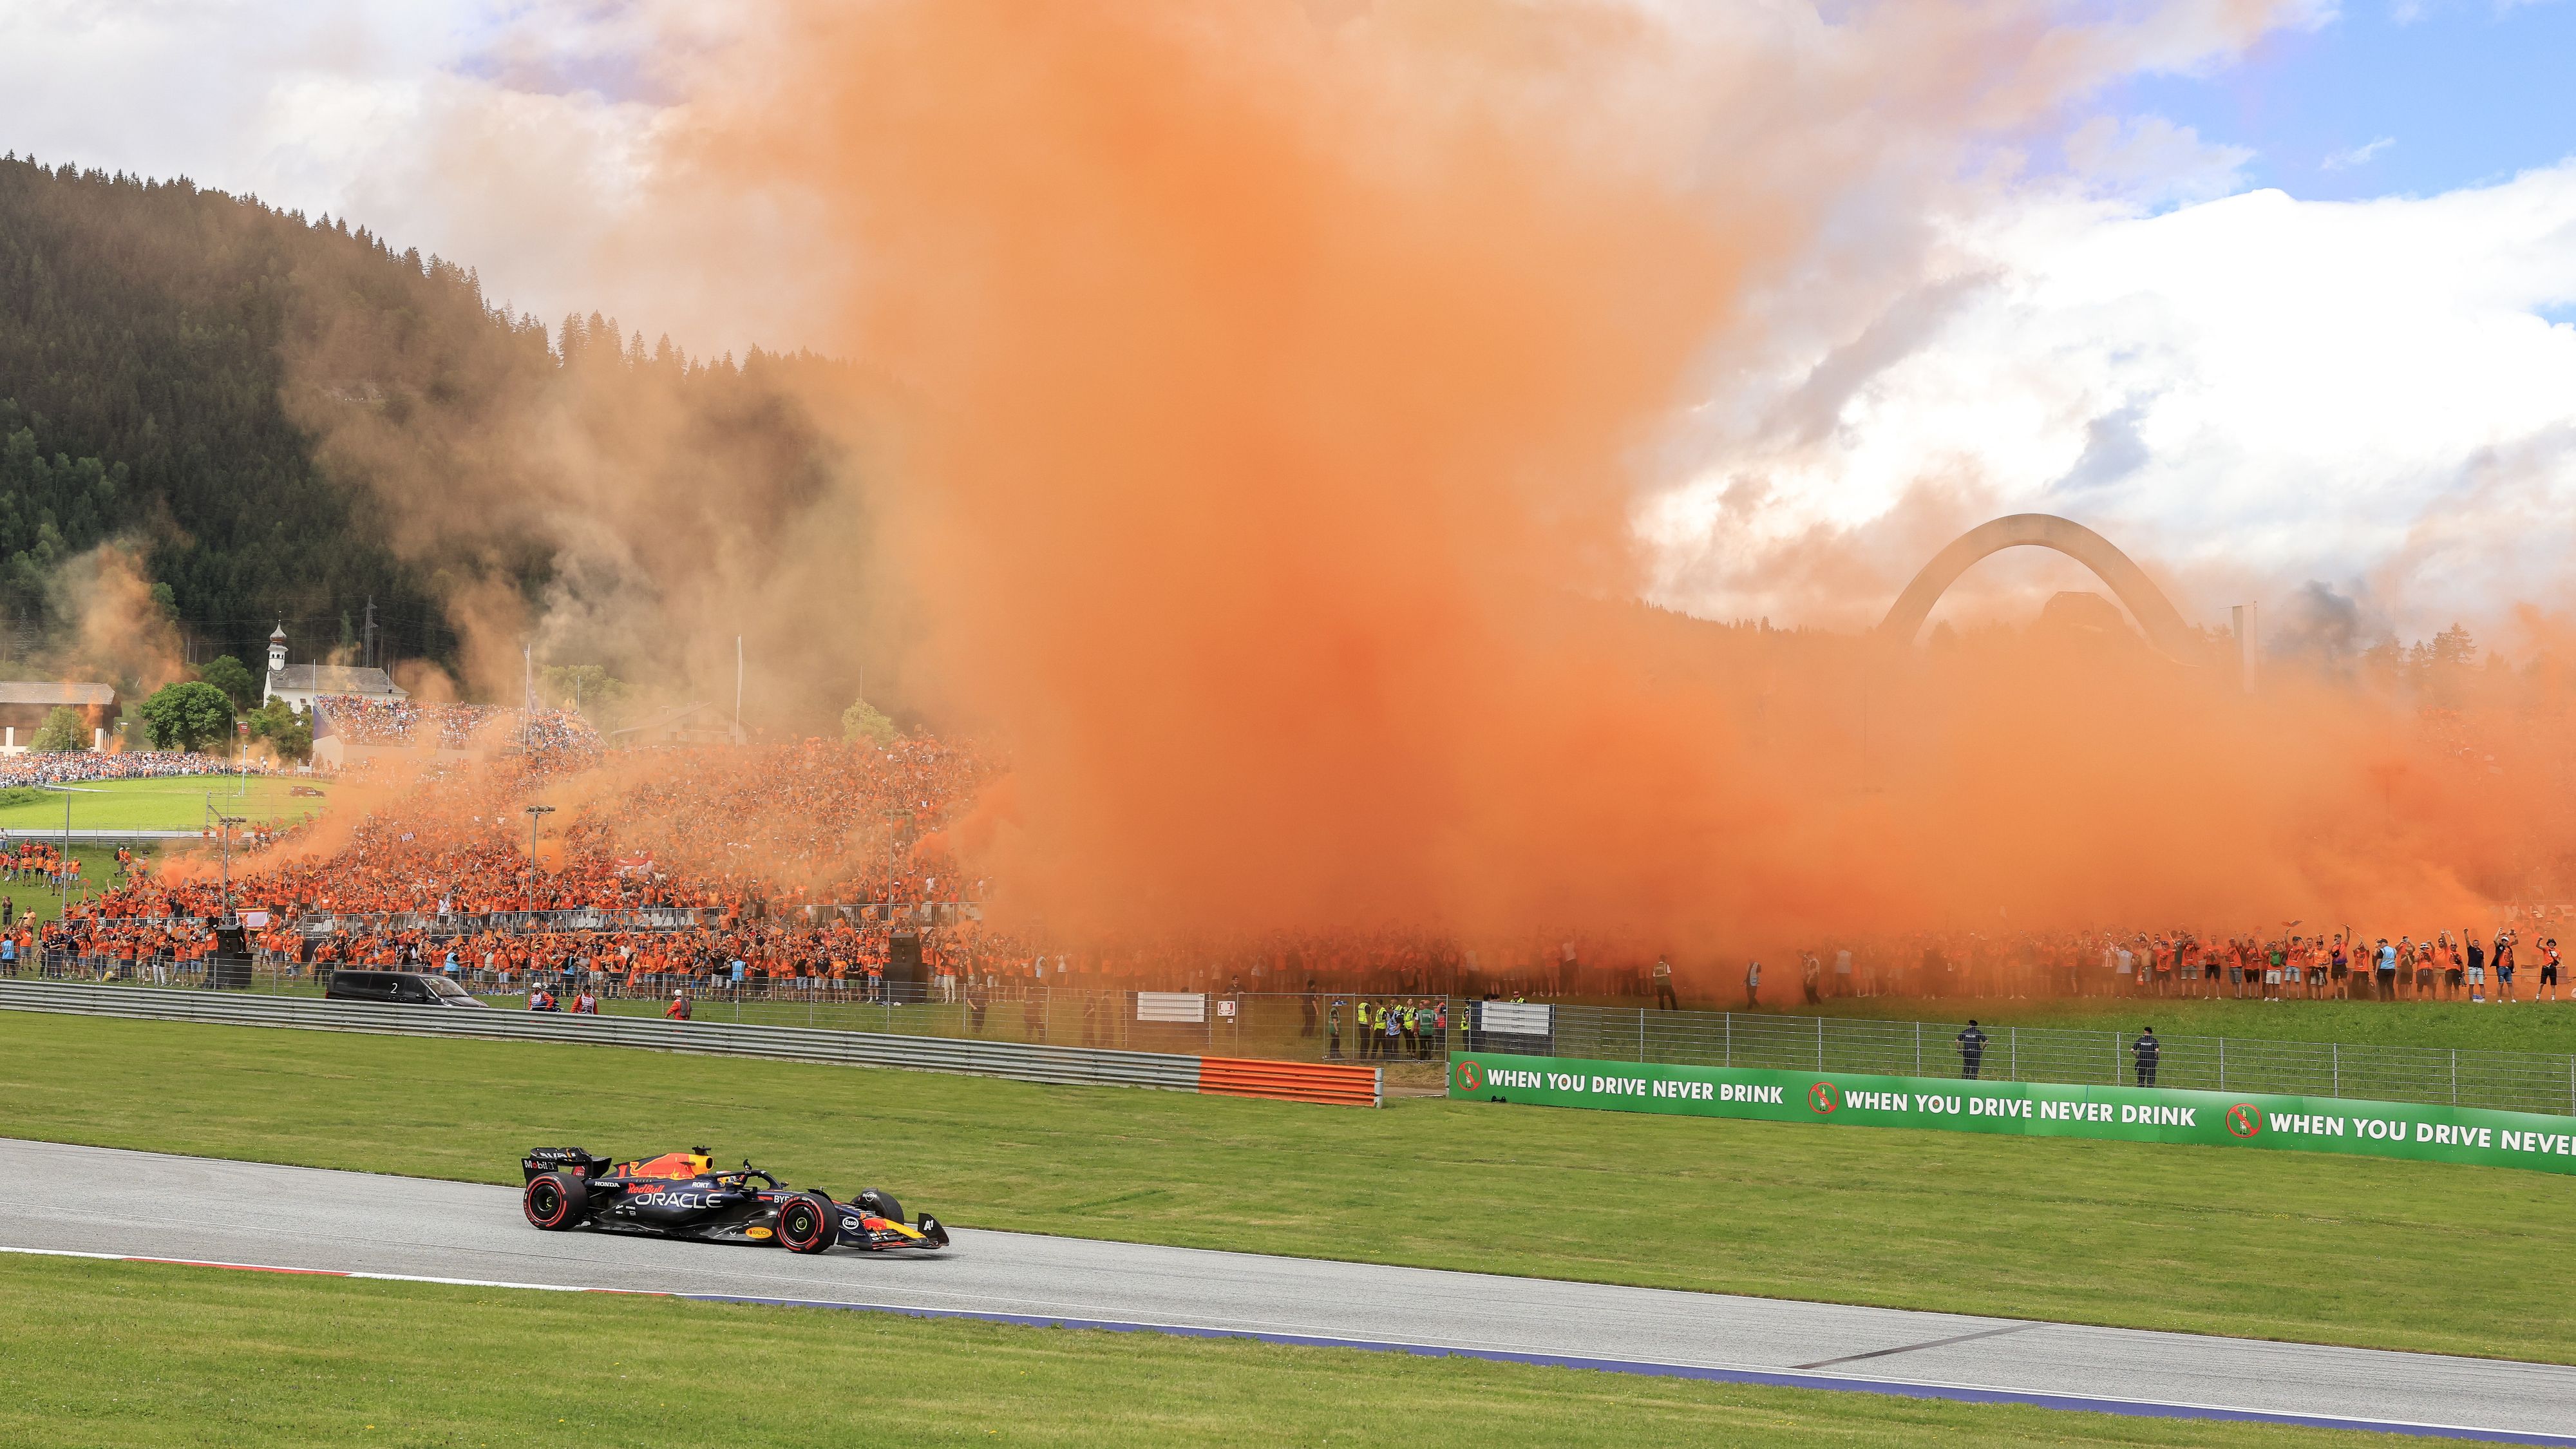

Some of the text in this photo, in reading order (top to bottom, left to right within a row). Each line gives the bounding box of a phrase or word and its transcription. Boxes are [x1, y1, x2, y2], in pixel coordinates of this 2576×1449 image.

[390, 983, 398, 994] 2
[1487, 1068, 1784, 1104] WHEN YOU DRIVE NEVER DRINK
[1844, 1090, 2197, 1127] WHEN YOU DRIVE NEVER DRINK
[2269, 1112, 2576, 1156] WHEN YOU DRIVE NEVE
[524, 1160, 548, 1170] Mobil
[618, 1164, 628, 1179] 1
[634, 1193, 724, 1209] ORACLE
[923, 1219, 934, 1231] A1
